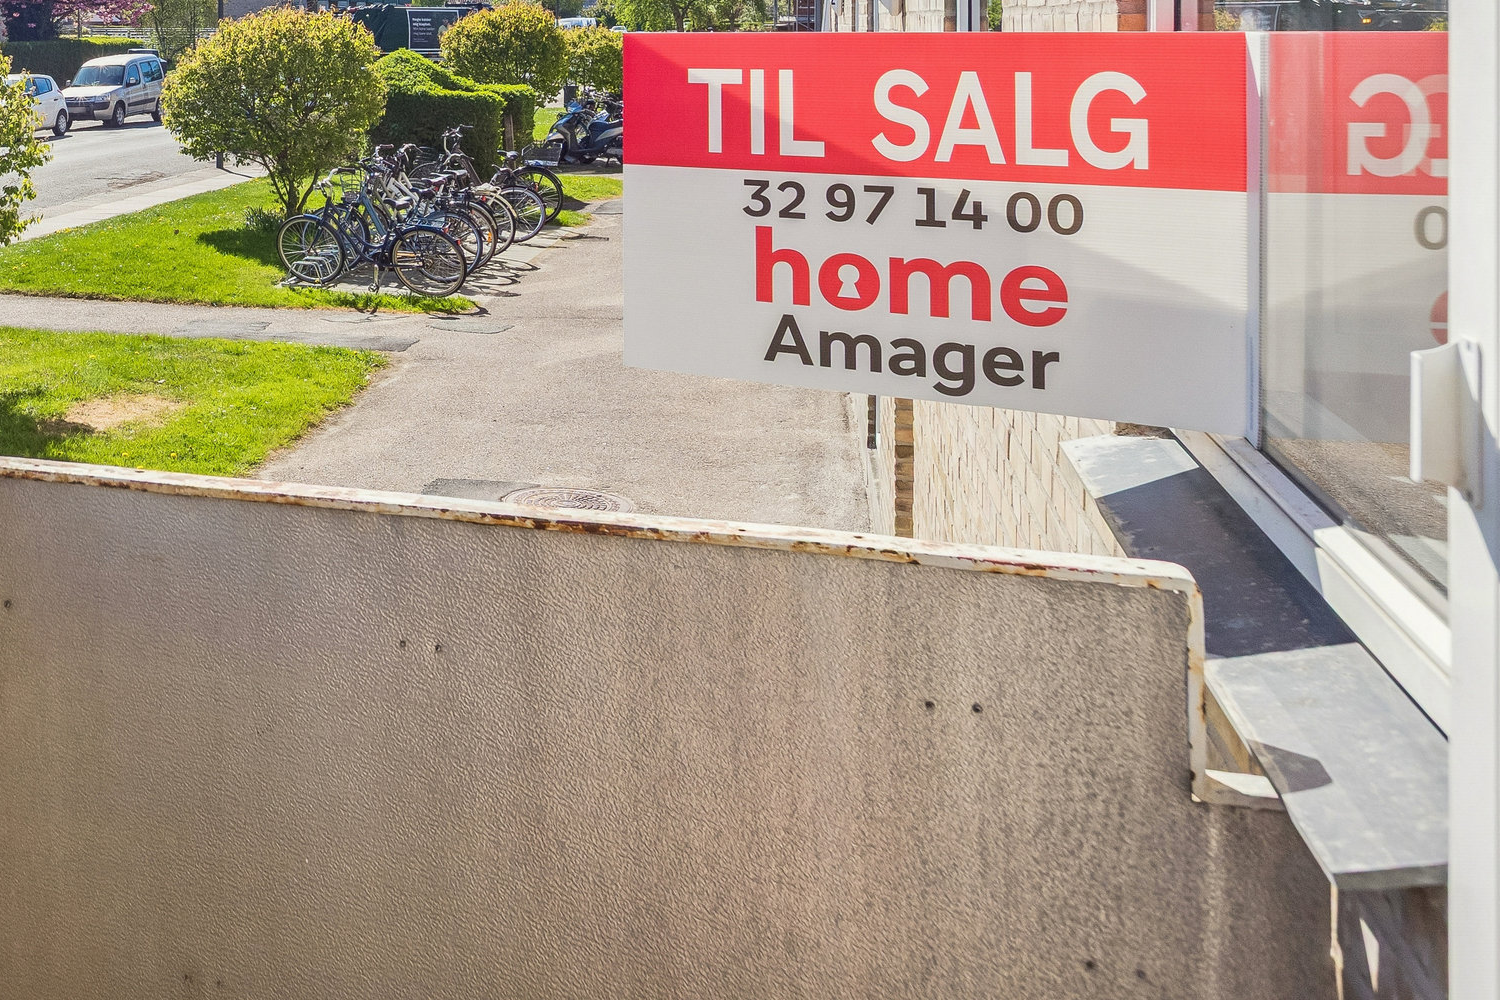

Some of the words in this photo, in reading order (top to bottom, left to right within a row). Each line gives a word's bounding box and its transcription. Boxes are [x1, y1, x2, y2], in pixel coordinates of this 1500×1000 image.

[688, 68, 825, 157] TIL
[871, 69, 1148, 170] SALG
[742, 178, 806, 220] 32
[825, 183, 895, 225] 97
[915, 187, 988, 230] 14
[1006, 191, 1084, 235] 00
[755, 225, 1069, 327] home
[763, 313, 1060, 397] Amager
